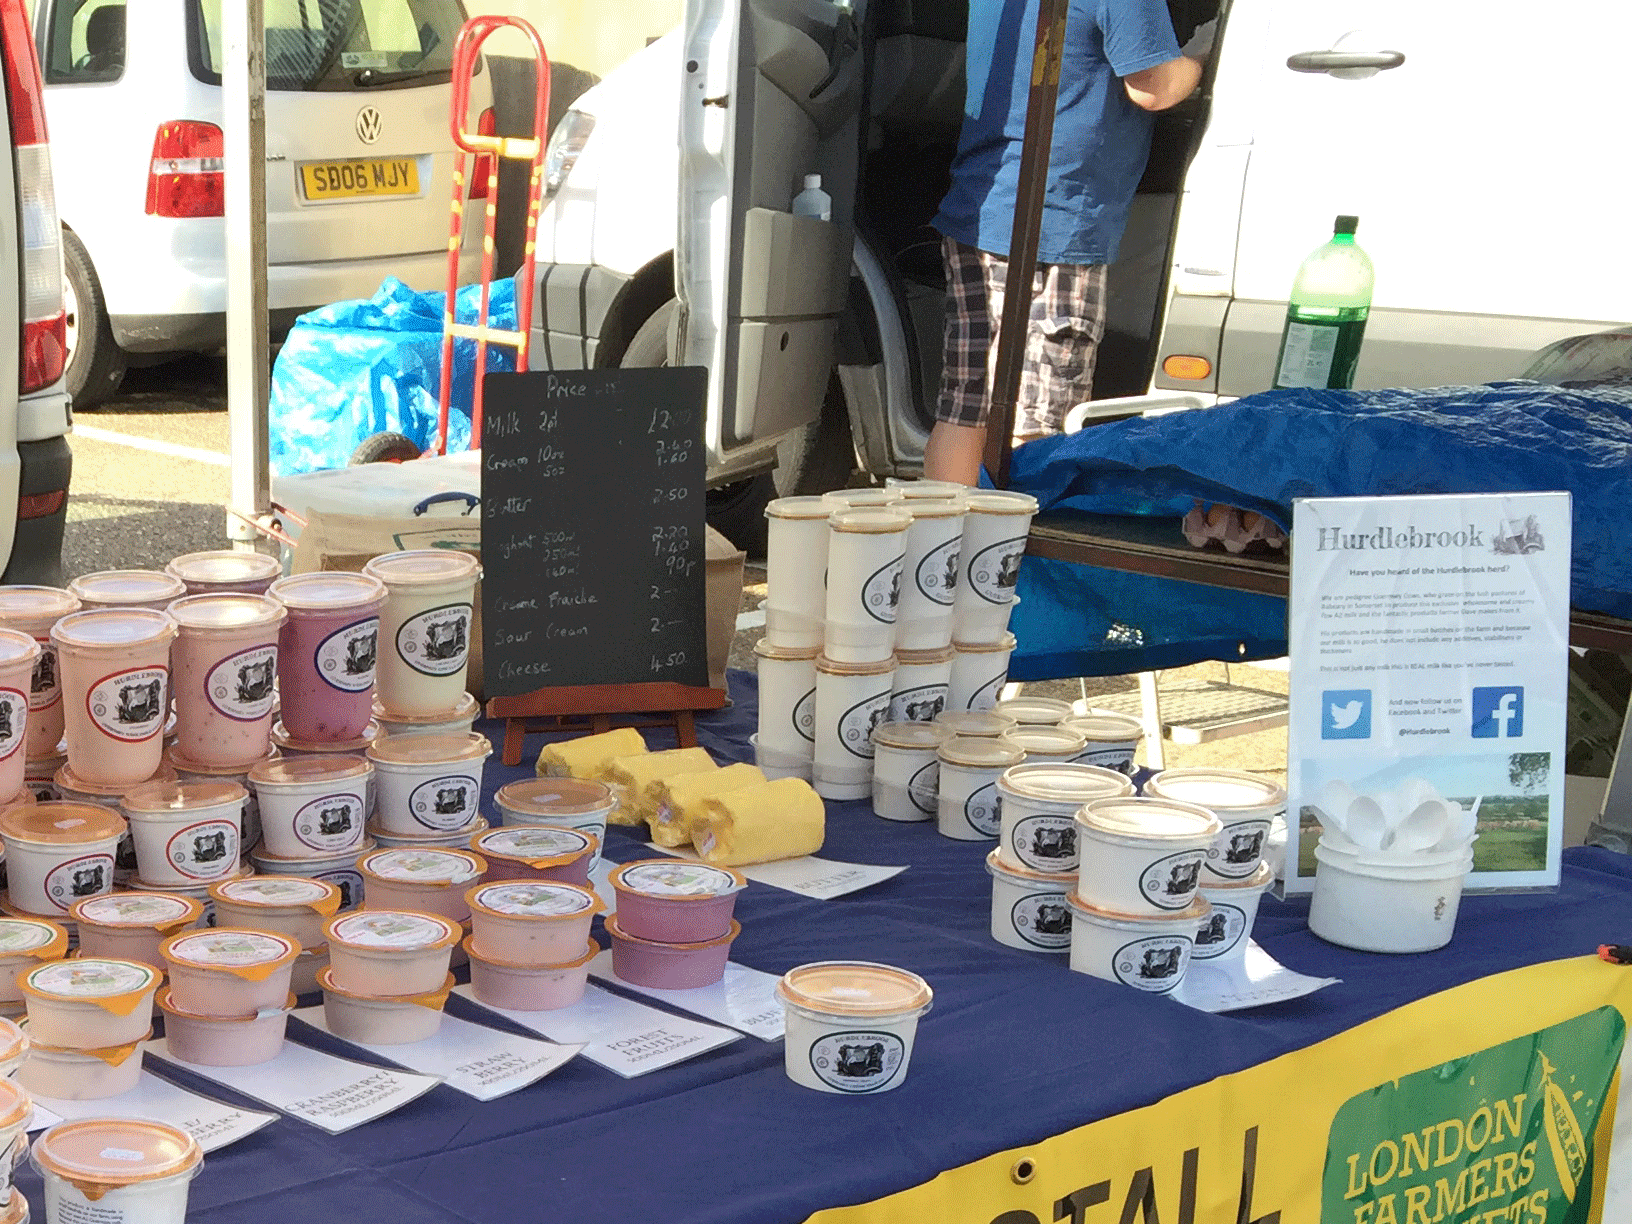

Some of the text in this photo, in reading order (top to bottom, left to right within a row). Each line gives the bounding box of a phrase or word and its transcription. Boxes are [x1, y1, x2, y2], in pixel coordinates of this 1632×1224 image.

[372, 161, 409, 188] MJY
[547, 374, 587, 398] Price
[486, 410, 520, 438] Milk
[1317, 524, 1484, 552] Hurdlebrook
[1412, 567, 1420, 575] of
[1421, 567, 1435, 575] the
[1437, 565, 1485, 575] Hurdlebrook
[1487, 564, 1510, 573] herd?
[495, 628, 532, 646] Sour
[545, 622, 588, 639] Cream
[498, 659, 551, 679] Cheese
[1437, 706, 1462, 715] Twitter
[606, 1028, 668, 1051] FOREST
[622, 1034, 684, 1056] FRUITS
[455, 1051, 512, 1074] STRAW
[474, 1057, 526, 1079] BERRY
[306, 1078, 398, 1116] RASPBERRY
[1344, 1093, 1528, 1201] LONDON
